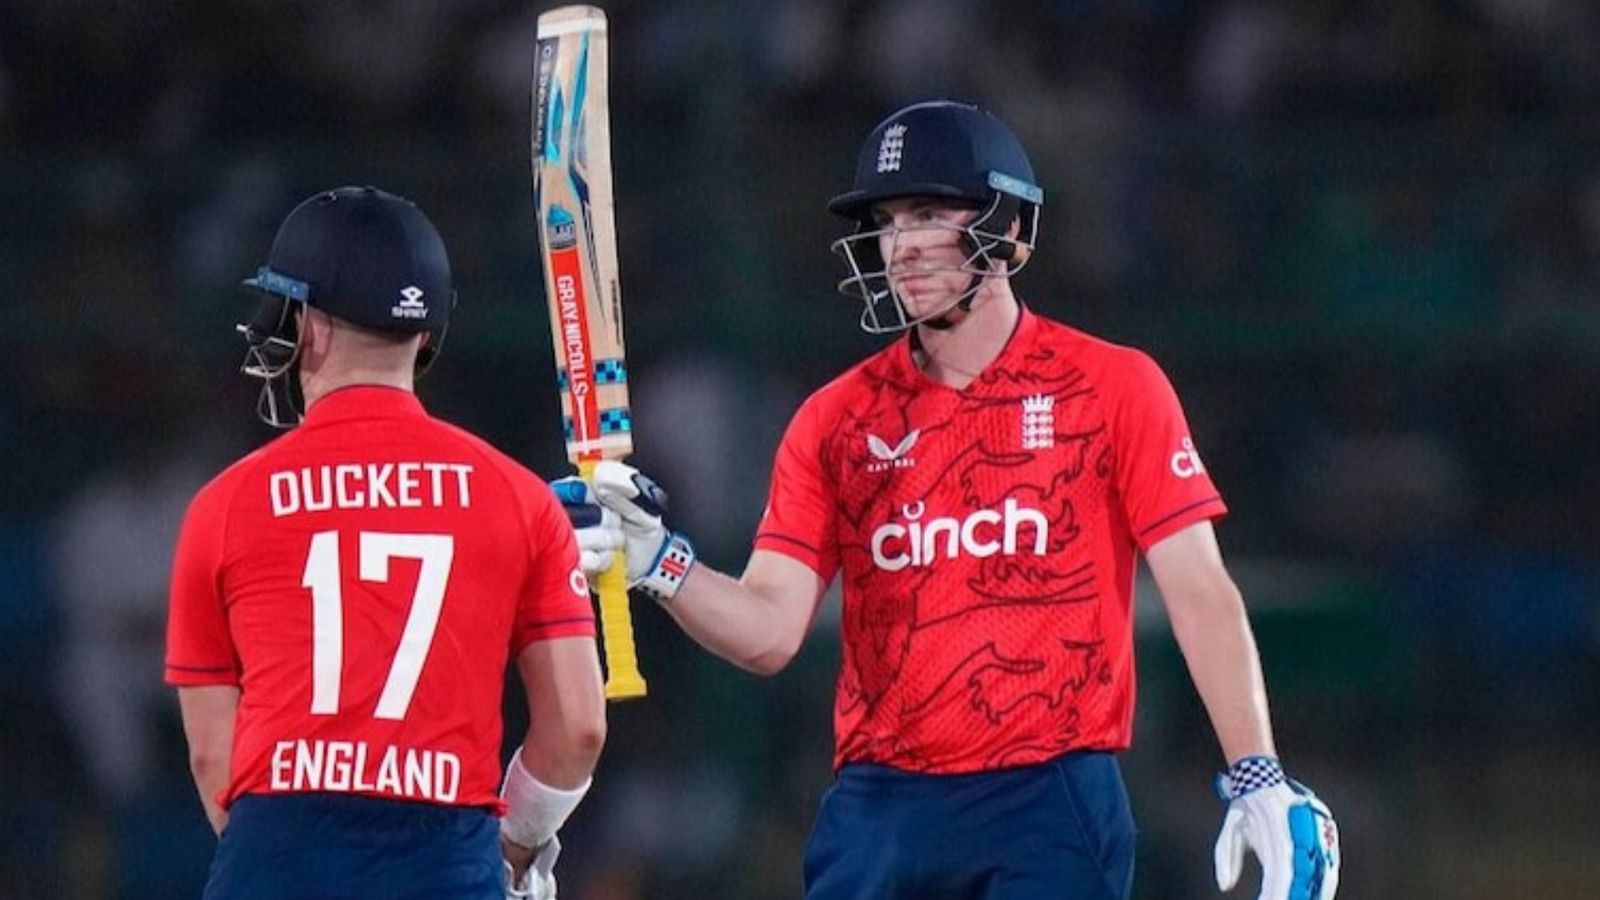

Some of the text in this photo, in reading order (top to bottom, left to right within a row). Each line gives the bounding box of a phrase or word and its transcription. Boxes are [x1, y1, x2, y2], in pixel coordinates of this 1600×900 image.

[270, 462, 474, 517] DUCKETT
[1170, 437, 1204, 479] ci
[870, 497, 1049, 572] cinch
[301, 529, 454, 721] 17
[270, 738, 461, 804] ENGLAND
